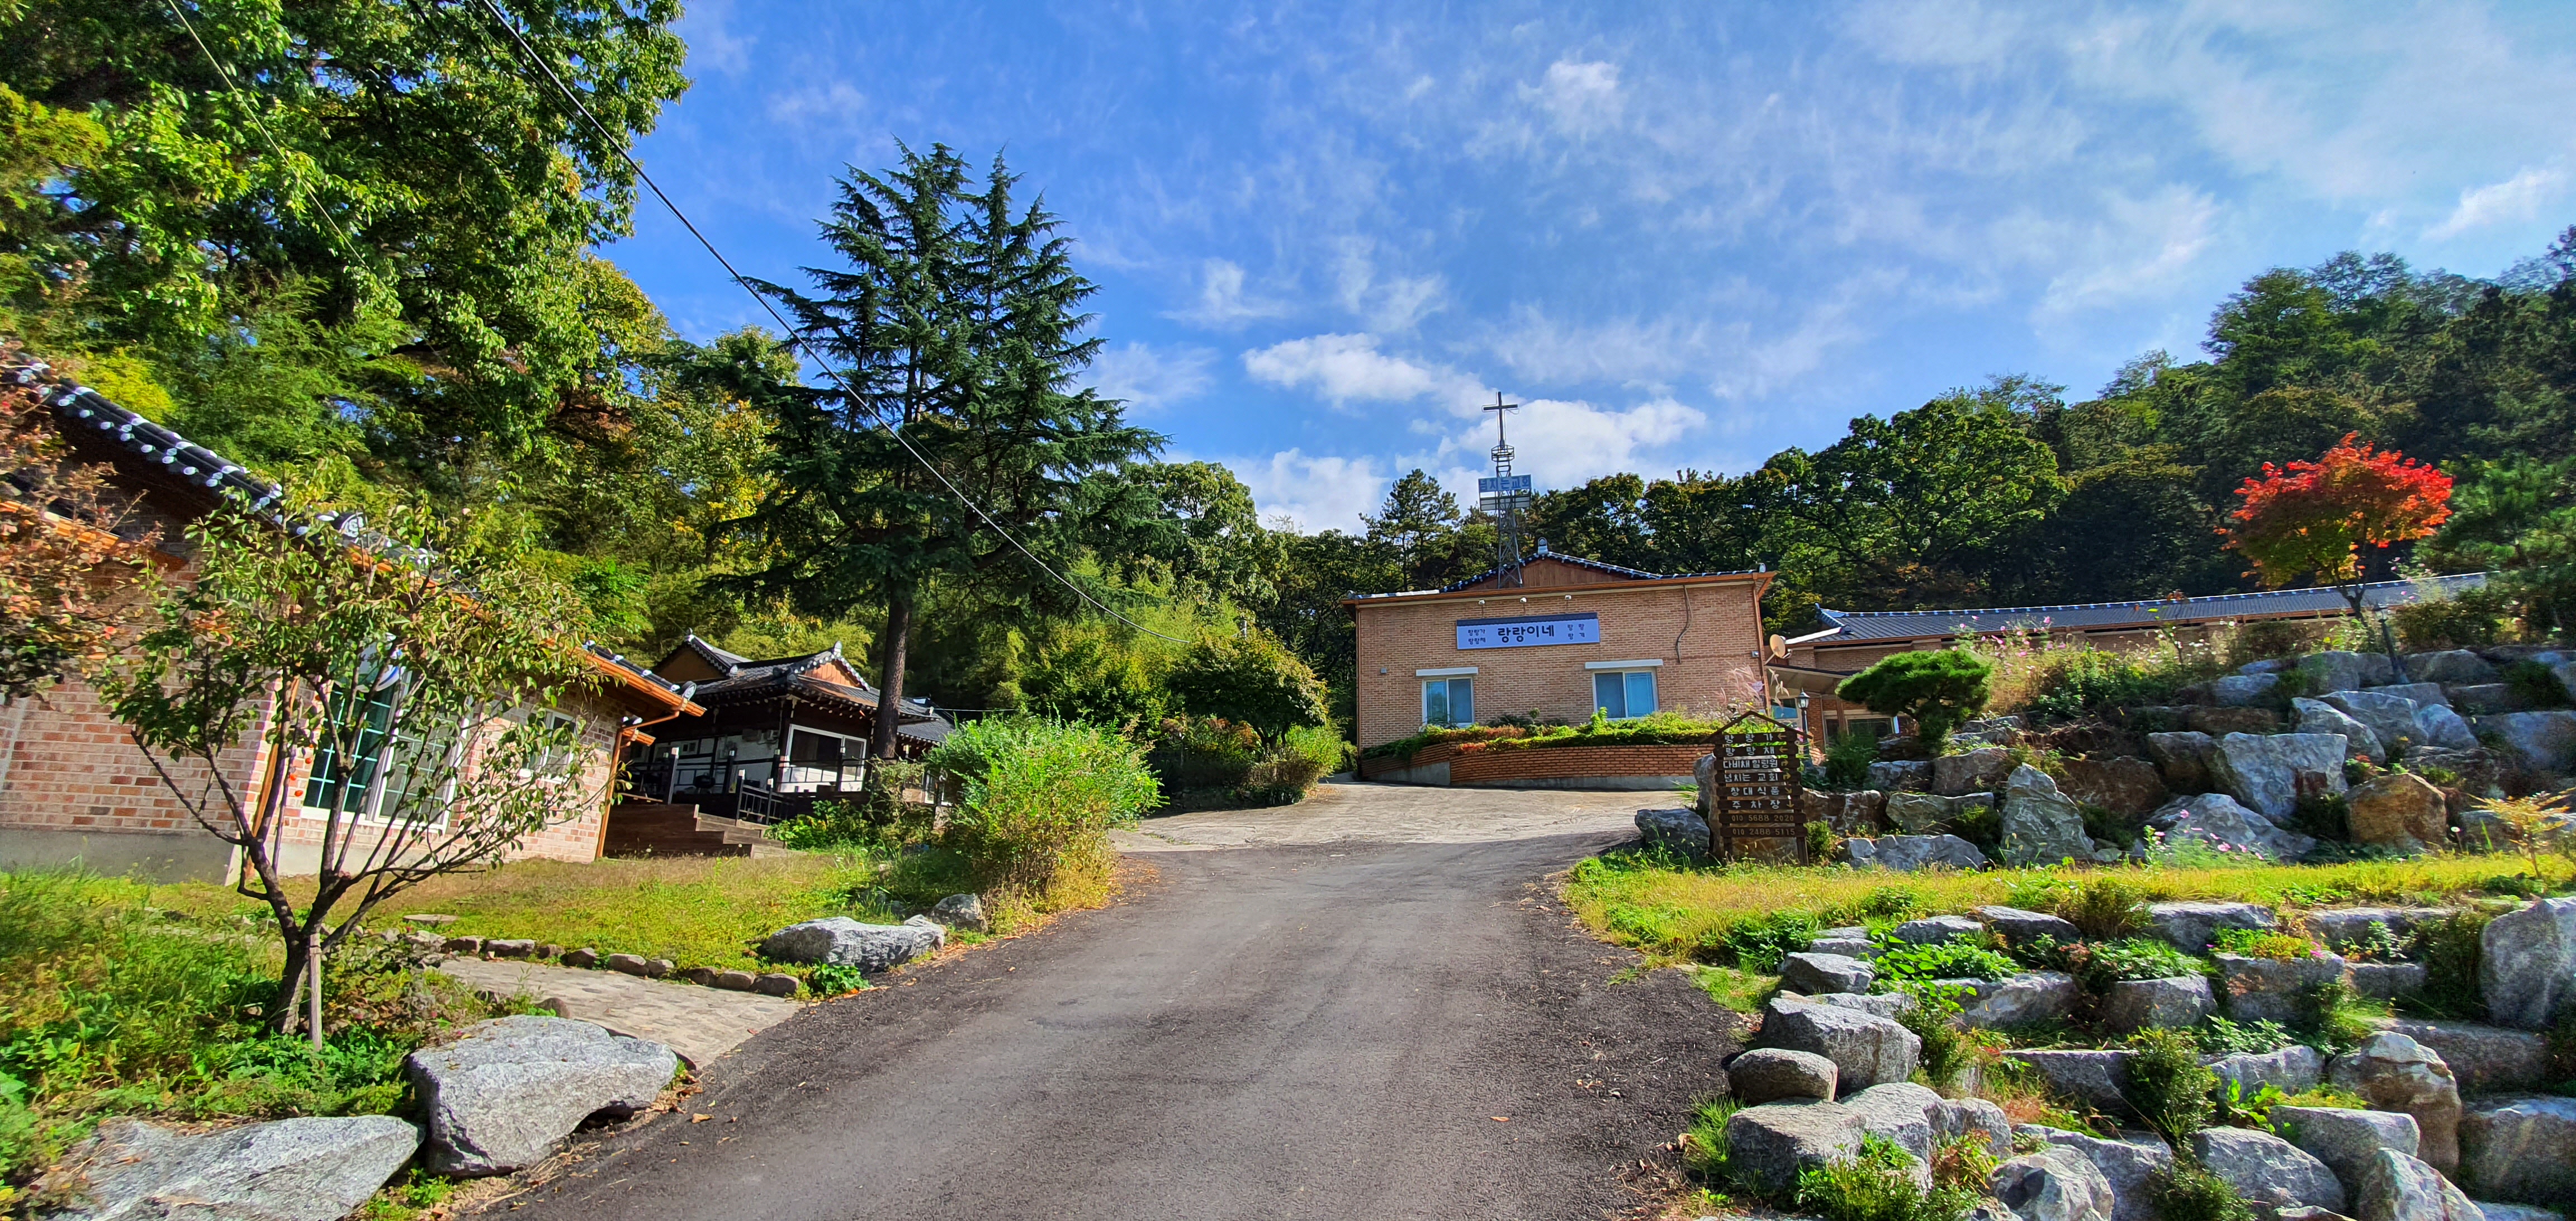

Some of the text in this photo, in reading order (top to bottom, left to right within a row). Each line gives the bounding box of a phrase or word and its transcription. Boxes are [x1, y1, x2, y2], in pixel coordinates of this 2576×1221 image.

[1498, 624, 1555, 643] 랑랑이네
[1724, 773, 1778, 782] 넘치는 교회
